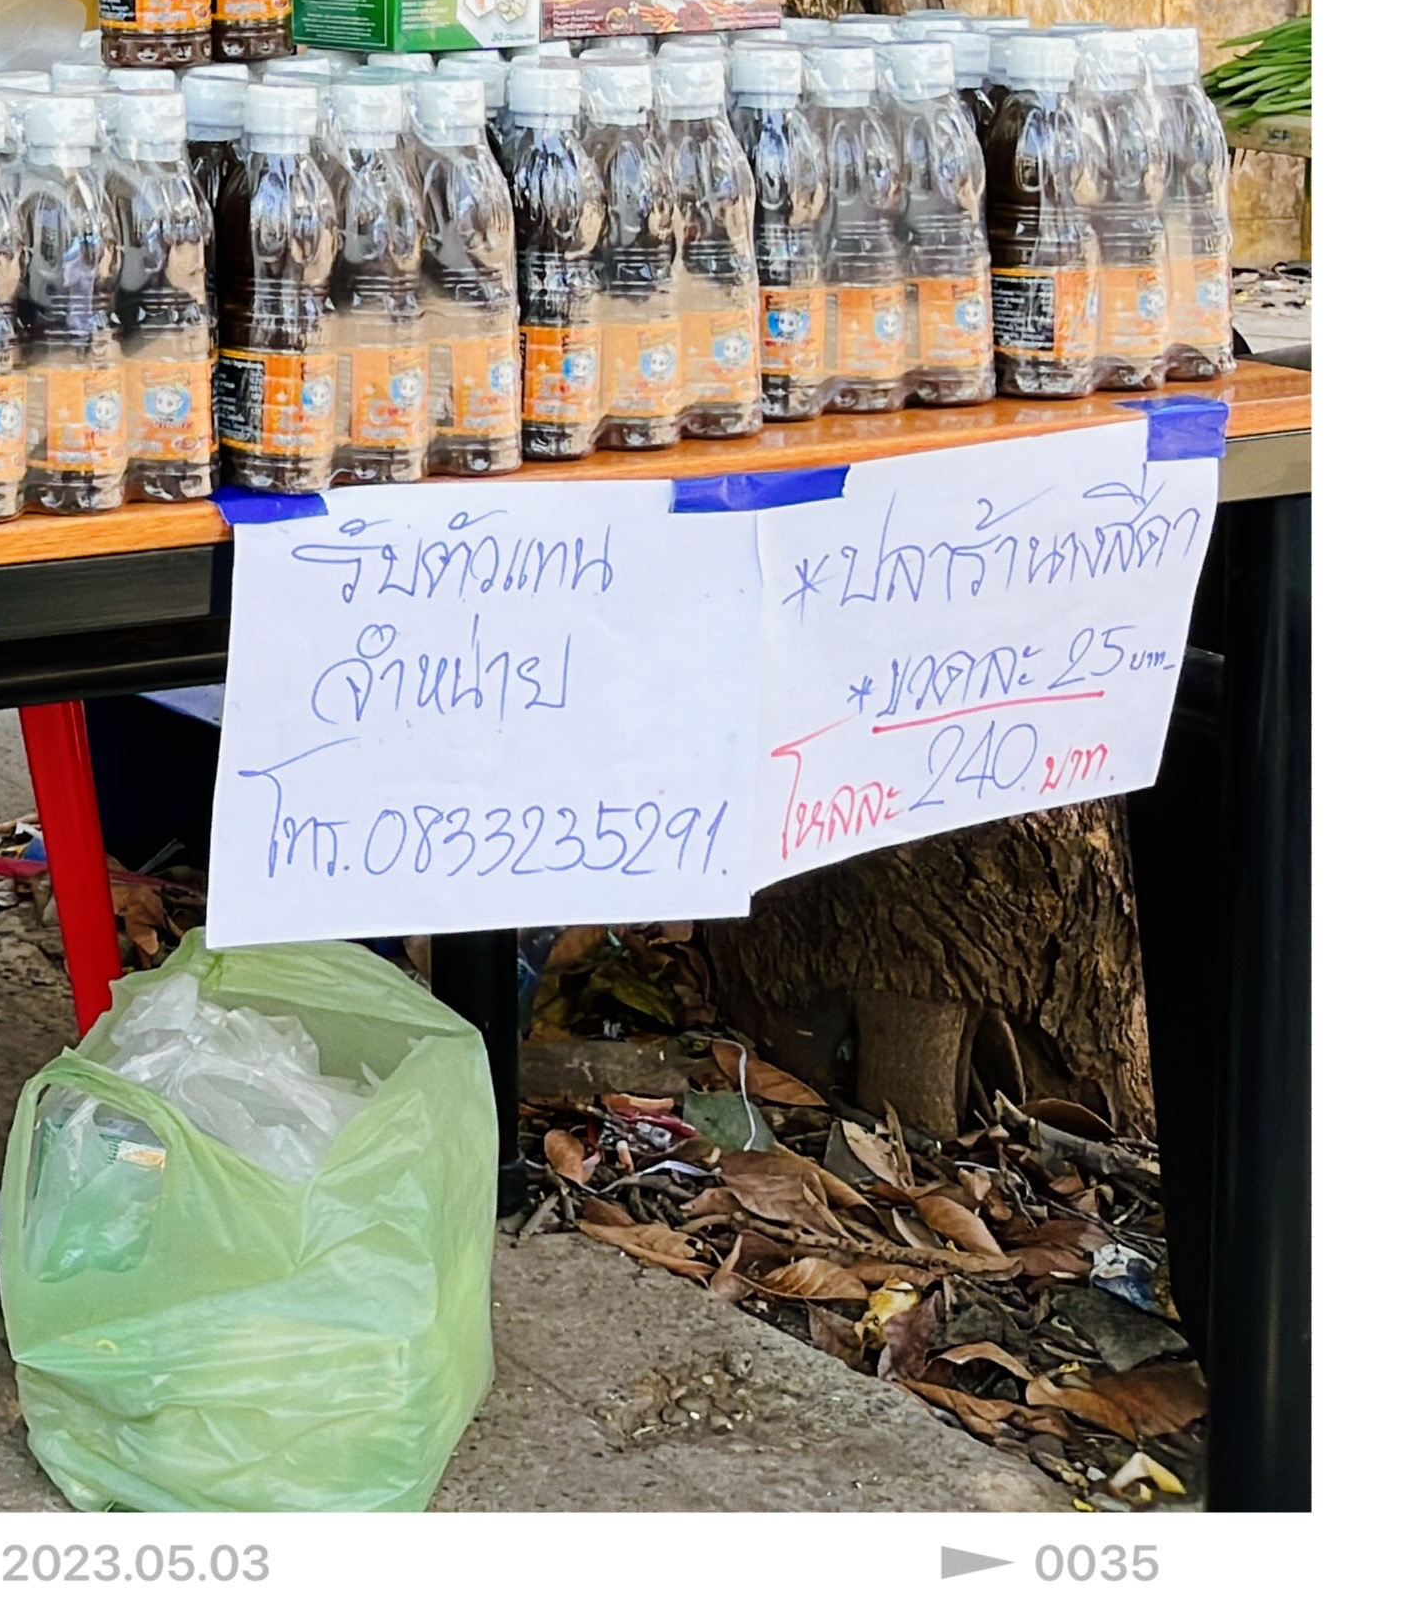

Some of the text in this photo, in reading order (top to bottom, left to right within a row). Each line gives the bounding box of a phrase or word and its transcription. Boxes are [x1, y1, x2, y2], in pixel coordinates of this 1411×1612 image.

[291, 510, 613, 605] รับตัวแทน
[310, 613, 570, 726] จำหน่าย
[1048, 625, 1136, 690] 25
